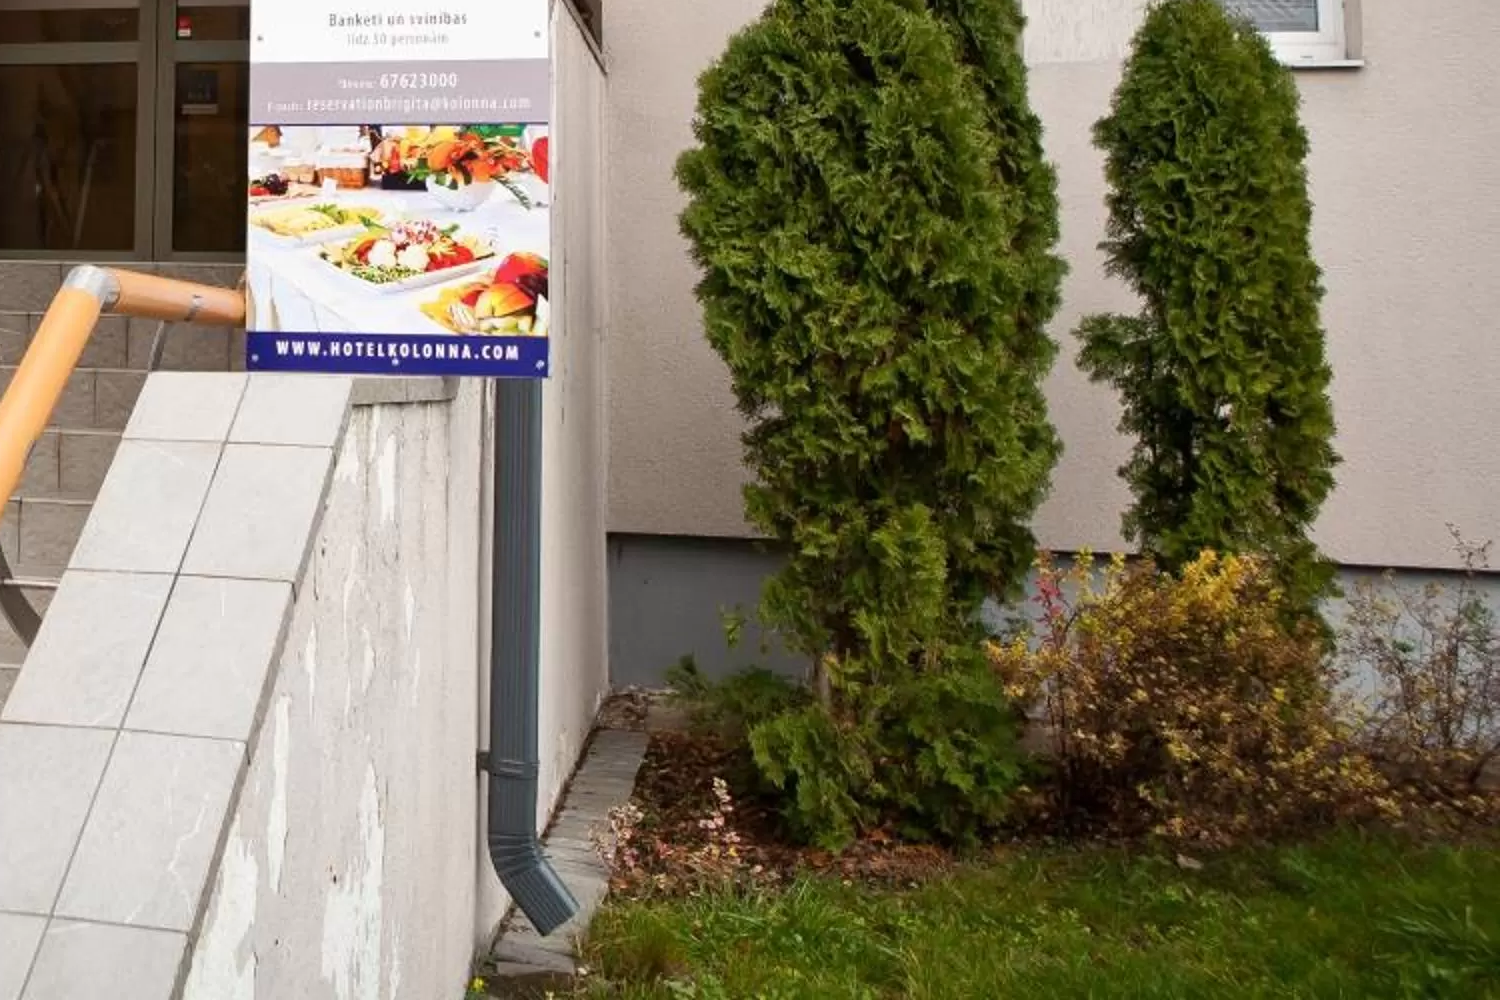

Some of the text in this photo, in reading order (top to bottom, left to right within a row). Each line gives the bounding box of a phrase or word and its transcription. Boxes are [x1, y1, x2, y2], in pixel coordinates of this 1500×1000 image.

[328, 12, 382, 27] Banketi
[387, 13, 405, 26] un
[379, 72, 458, 89] 67623000
[276, 339, 519, 361] WWW.HOTELKOLONNA.COM
